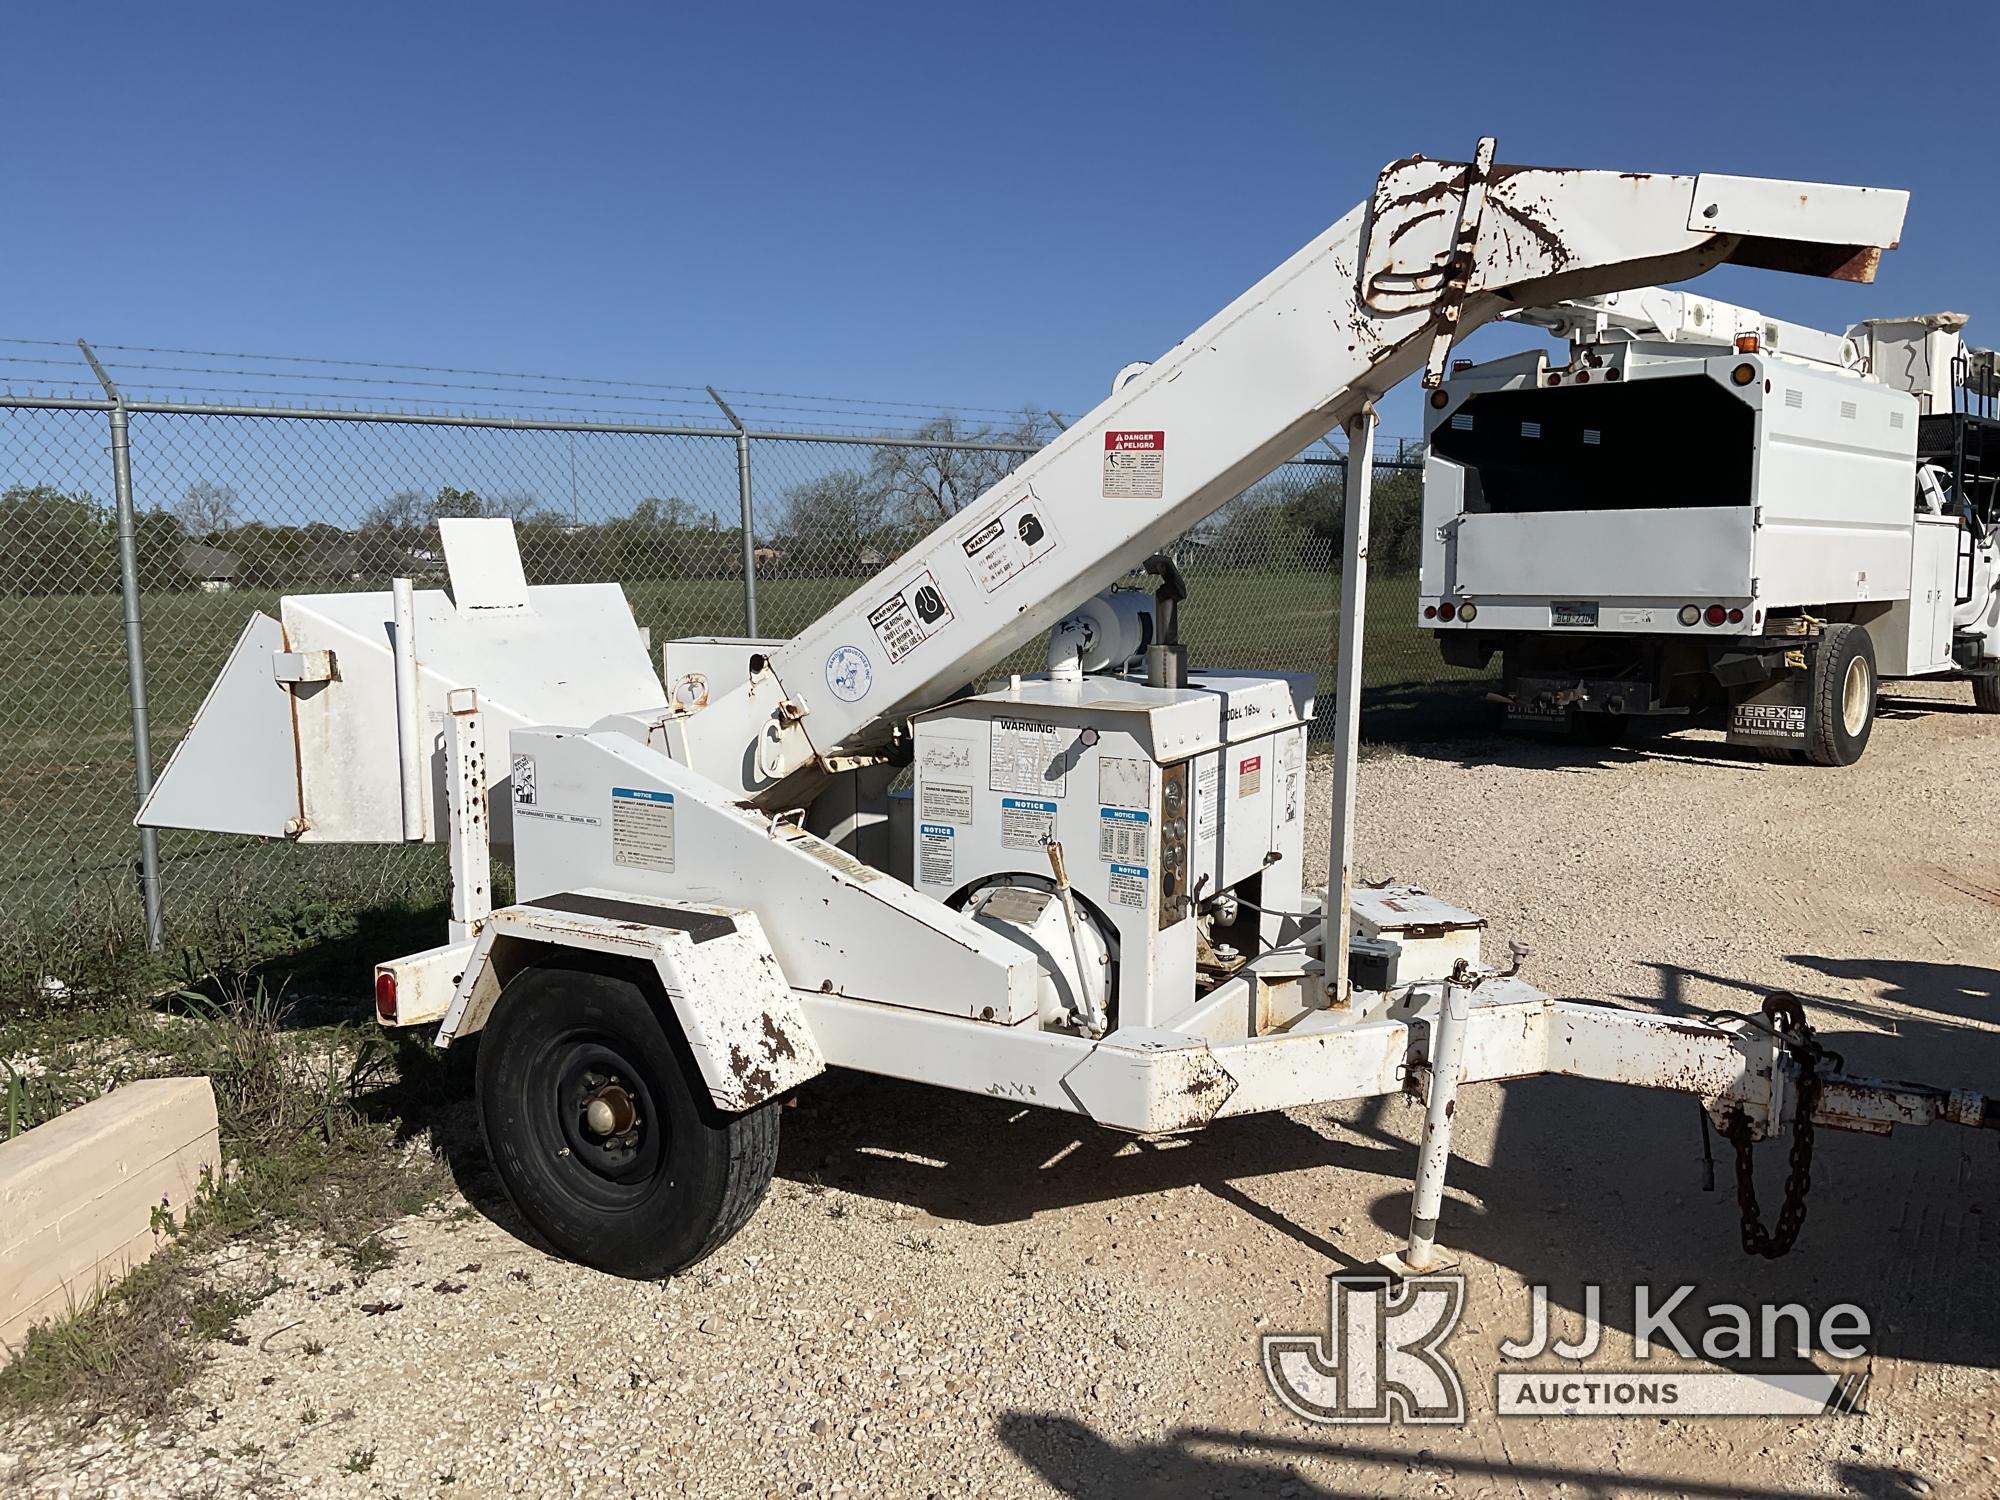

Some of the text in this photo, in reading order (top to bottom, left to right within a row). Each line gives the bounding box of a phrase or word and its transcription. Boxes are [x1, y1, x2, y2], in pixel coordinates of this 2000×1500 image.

[969, 526, 998, 550] WARNING
[873, 599, 901, 622] WARNING
[883, 613, 904, 631] HEARING
[883, 618, 912, 643] PROTECTION
[890, 628, 914, 648] REQUIRED
[1220, 707, 1243, 723] MODEL
[1735, 706, 1787, 718] TEREX
[1000, 720, 1056, 735] WARNING!
[1734, 717, 1805, 730] UTILITIES
[1014, 801, 1044, 810] NOTICE
[1114, 811, 1136, 819] NOTICE
[924, 826, 951, 835] NOTICE
[1118, 866, 1140, 875] NOTICE
